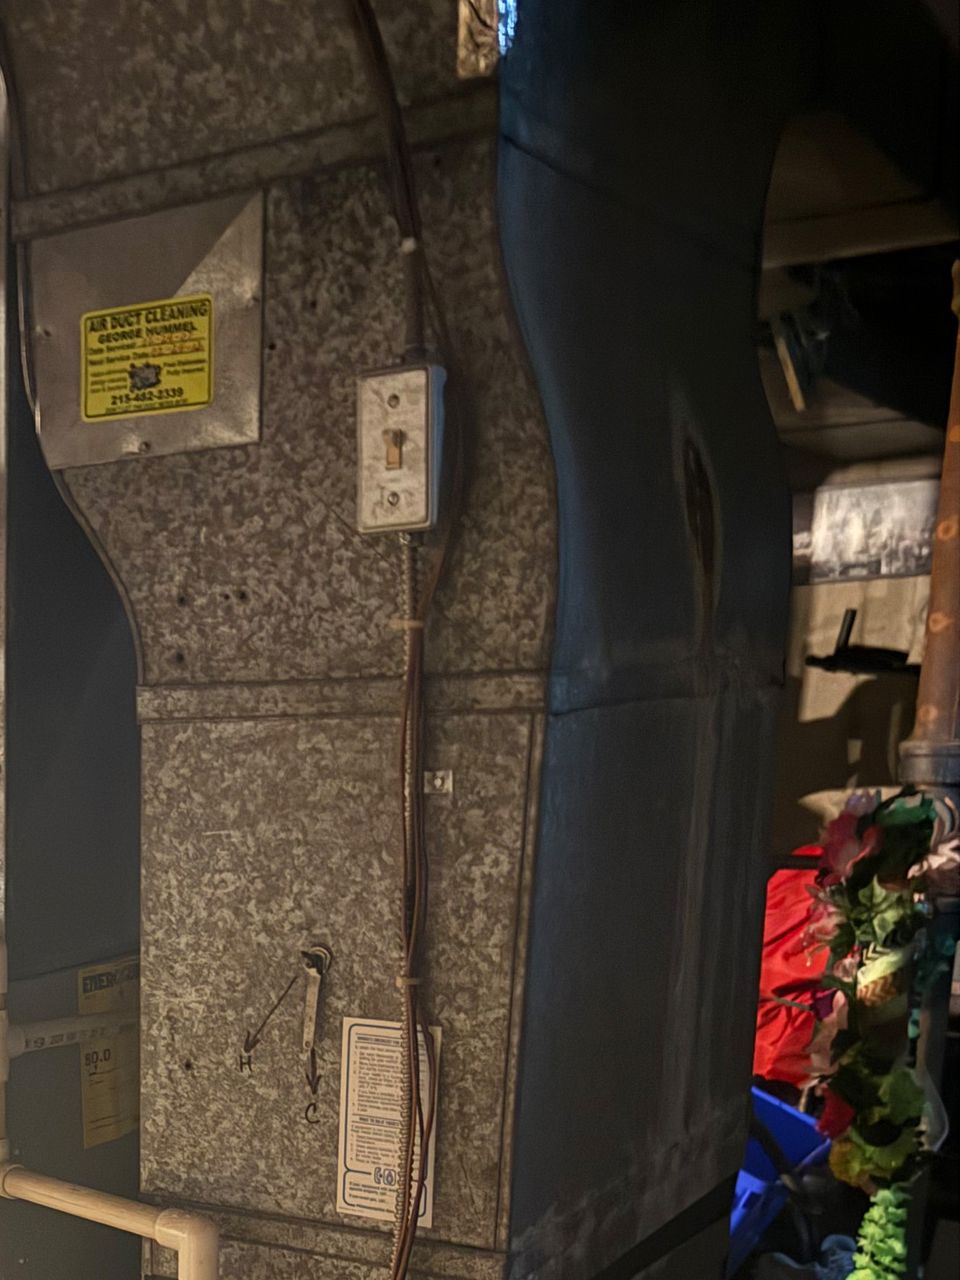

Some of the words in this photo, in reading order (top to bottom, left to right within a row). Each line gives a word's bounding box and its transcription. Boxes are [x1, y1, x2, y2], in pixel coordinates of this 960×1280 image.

[89, 318, 108, 332] AIR
[111, 312, 141, 329] DUCT
[145, 303, 207, 323] CLEANING
[98, 328, 143, 344] GEORGE
[239, 1054, 253, 1073] H
[305, 1102, 321, 1124] C
